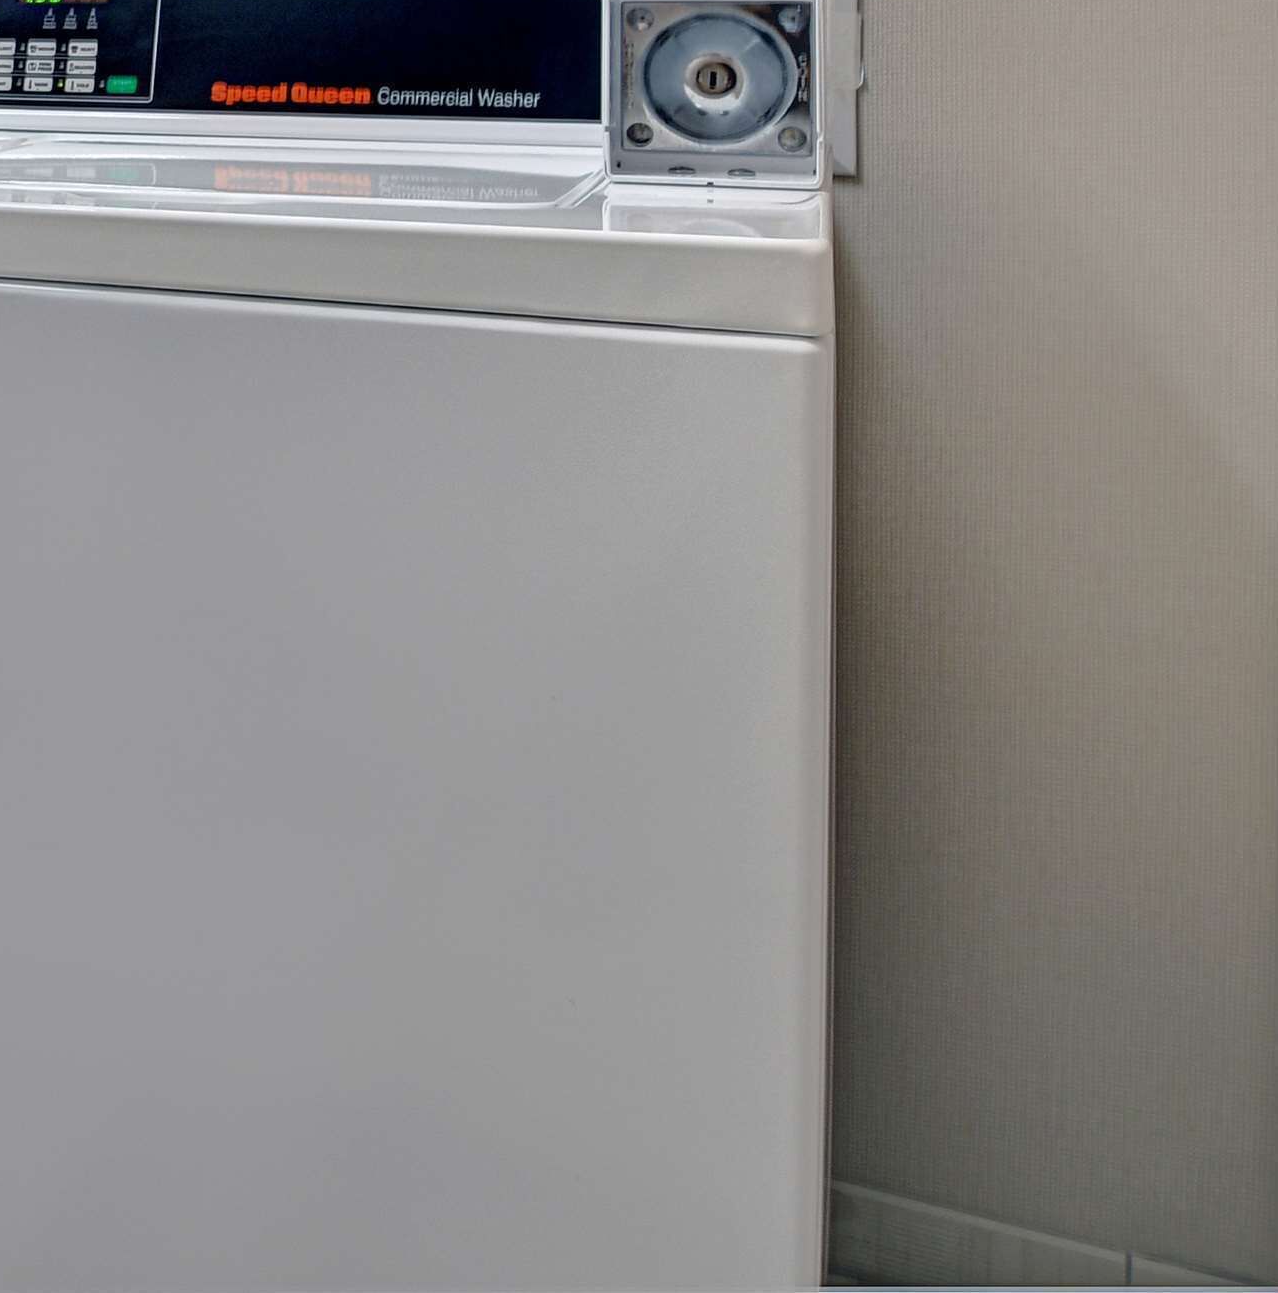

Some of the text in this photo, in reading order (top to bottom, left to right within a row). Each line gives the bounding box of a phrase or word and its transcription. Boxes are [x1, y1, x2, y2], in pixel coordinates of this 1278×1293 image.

[211, 81, 541, 108] Speed Queen Commercial Washer
